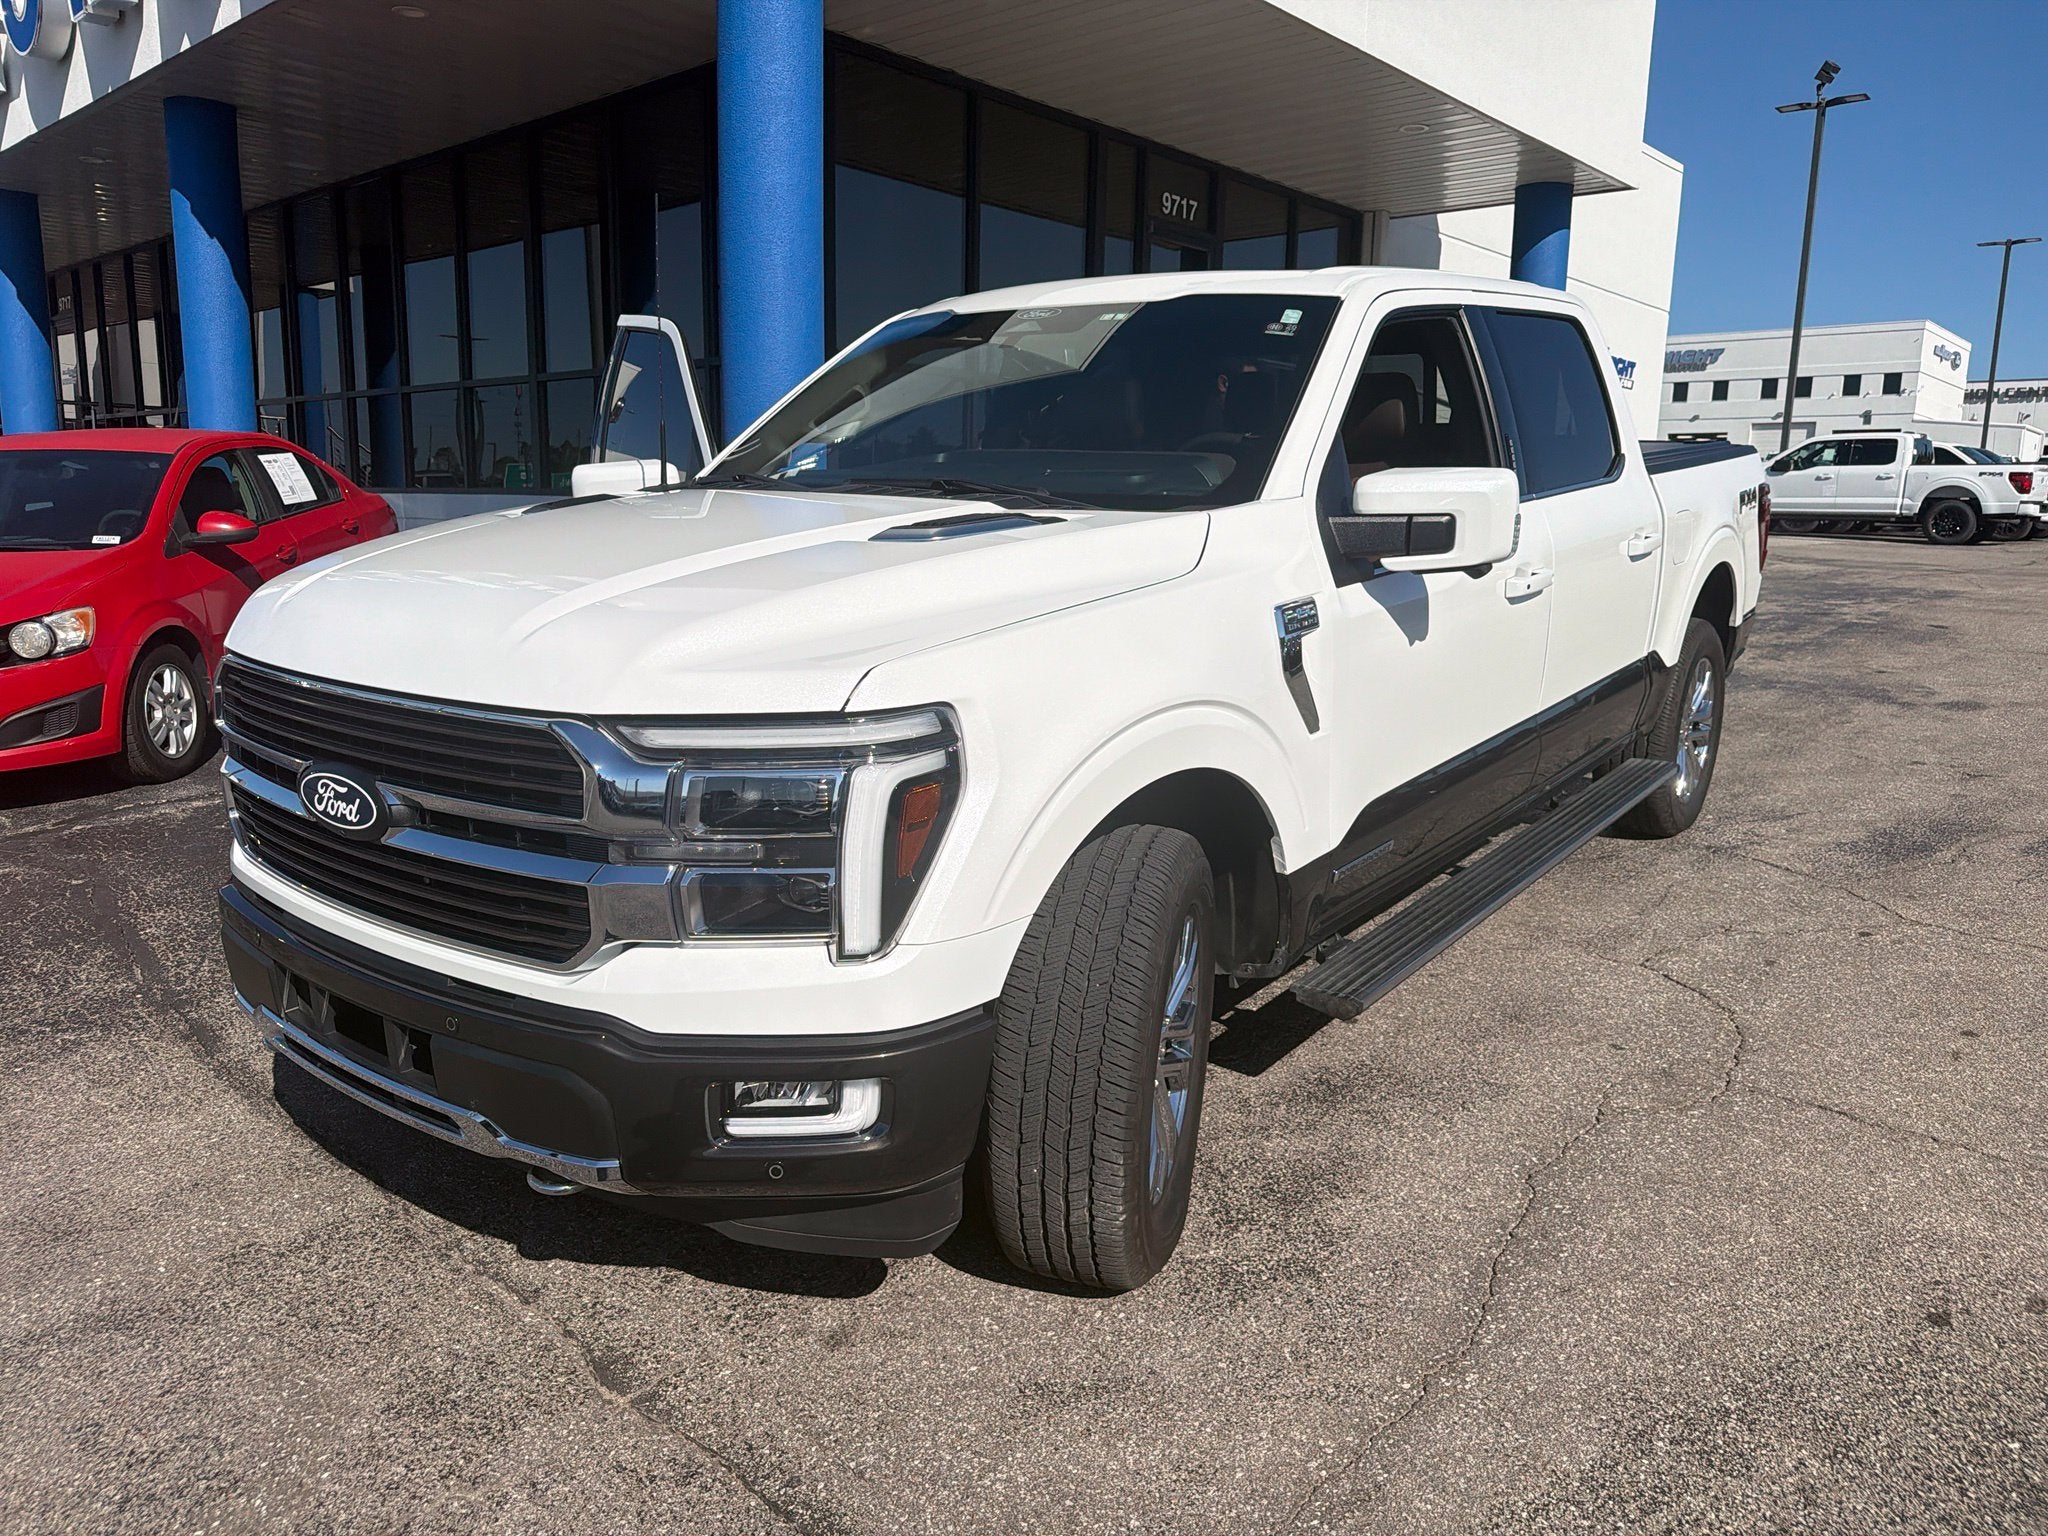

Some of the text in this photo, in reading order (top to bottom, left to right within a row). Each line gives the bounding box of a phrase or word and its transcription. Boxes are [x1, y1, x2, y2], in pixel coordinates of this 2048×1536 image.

[1162, 192, 1198, 221] 9717
[58, 295, 71, 311] 9717
[314, 779, 361, 823] Ford
